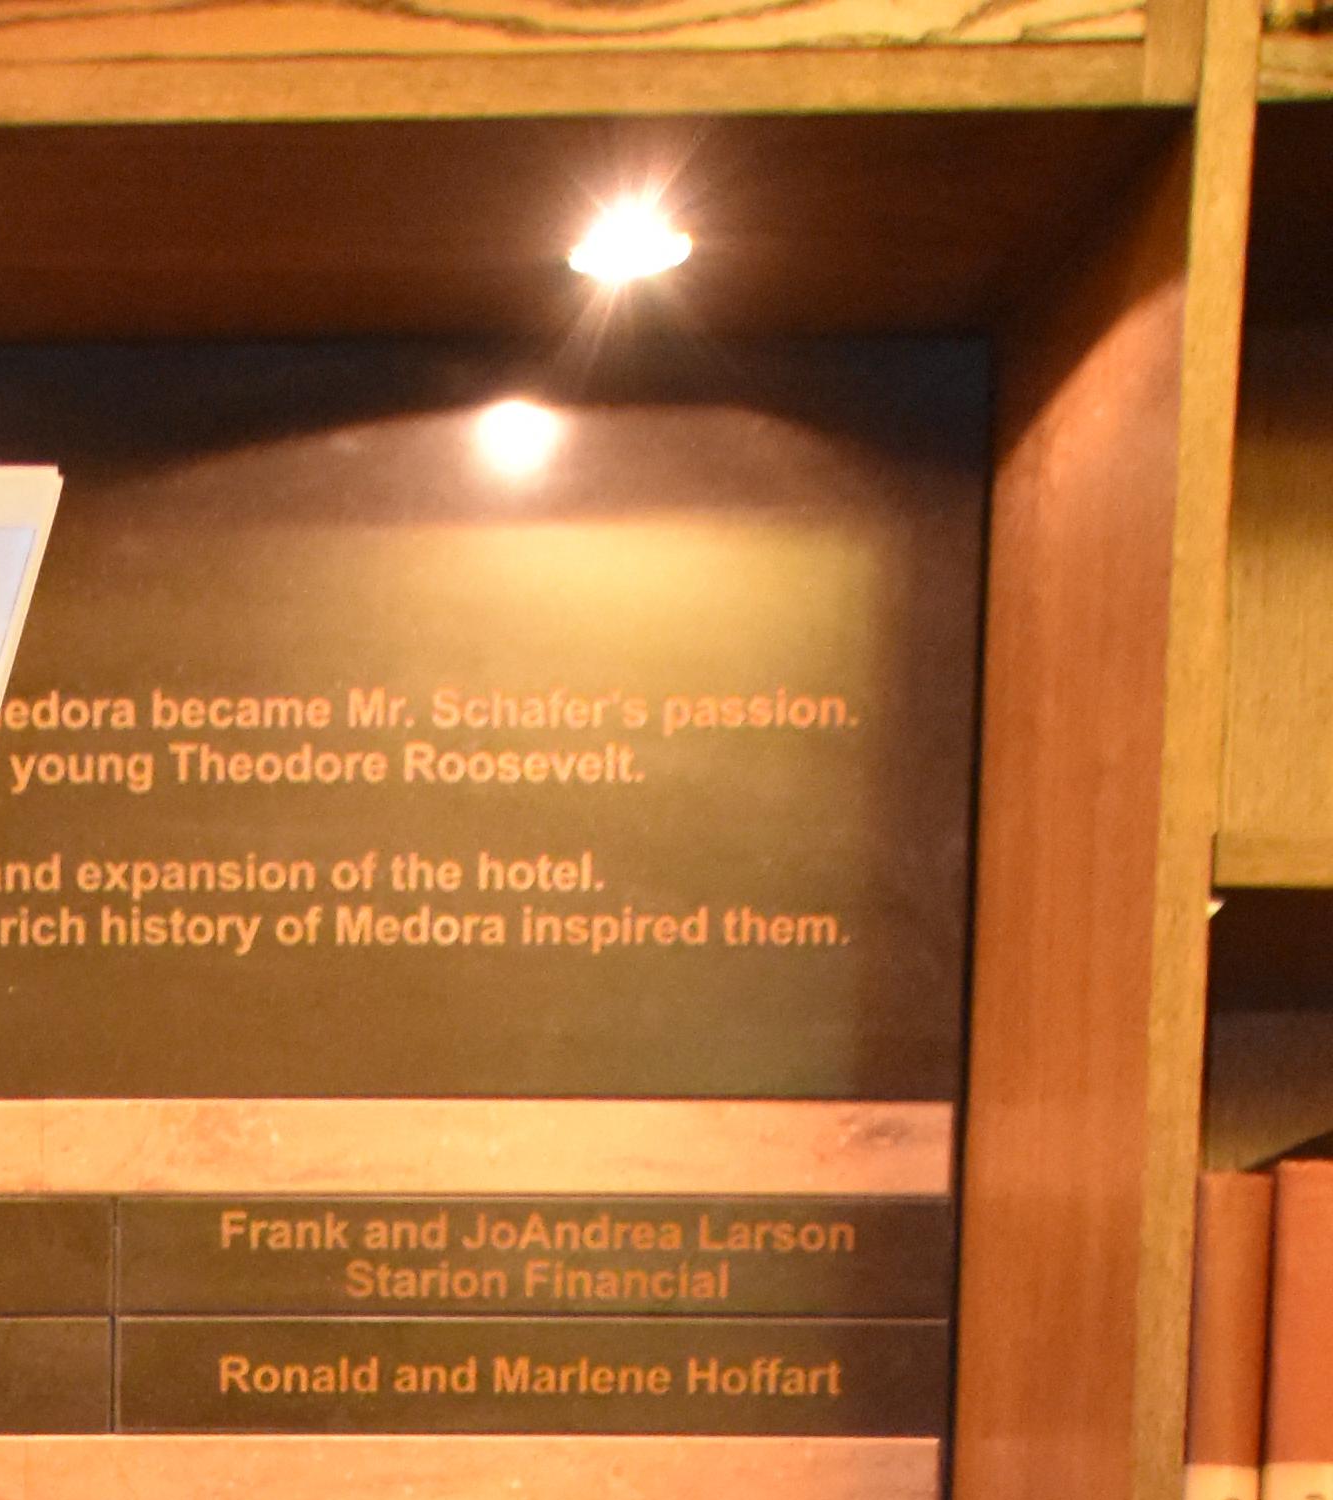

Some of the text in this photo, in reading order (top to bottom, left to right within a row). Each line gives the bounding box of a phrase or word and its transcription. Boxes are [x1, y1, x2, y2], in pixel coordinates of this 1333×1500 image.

[0, 683, 857, 737] edora became Mr. Schafer's passion.
[10, 740, 645, 793] young Theodore Roosevelt.
[76, 852, 316, 901] expansion
[330, 850, 377, 891] of
[390, 852, 463, 891] the
[477, 851, 604, 892] hotel.
[0, 906, 86, 946] rich
[100, 905, 262, 956] history
[275, 905, 323, 945] of
[335, 904, 506, 946] Medora
[521, 905, 709, 954] inspired
[723, 906, 849, 946] them.
[220, 1209, 854, 1252] Frank and JoAndrea Larson
[346, 1259, 729, 1300] Starion Financial
[219, 1355, 841, 1396] Ronald and Marlene Hoffart
